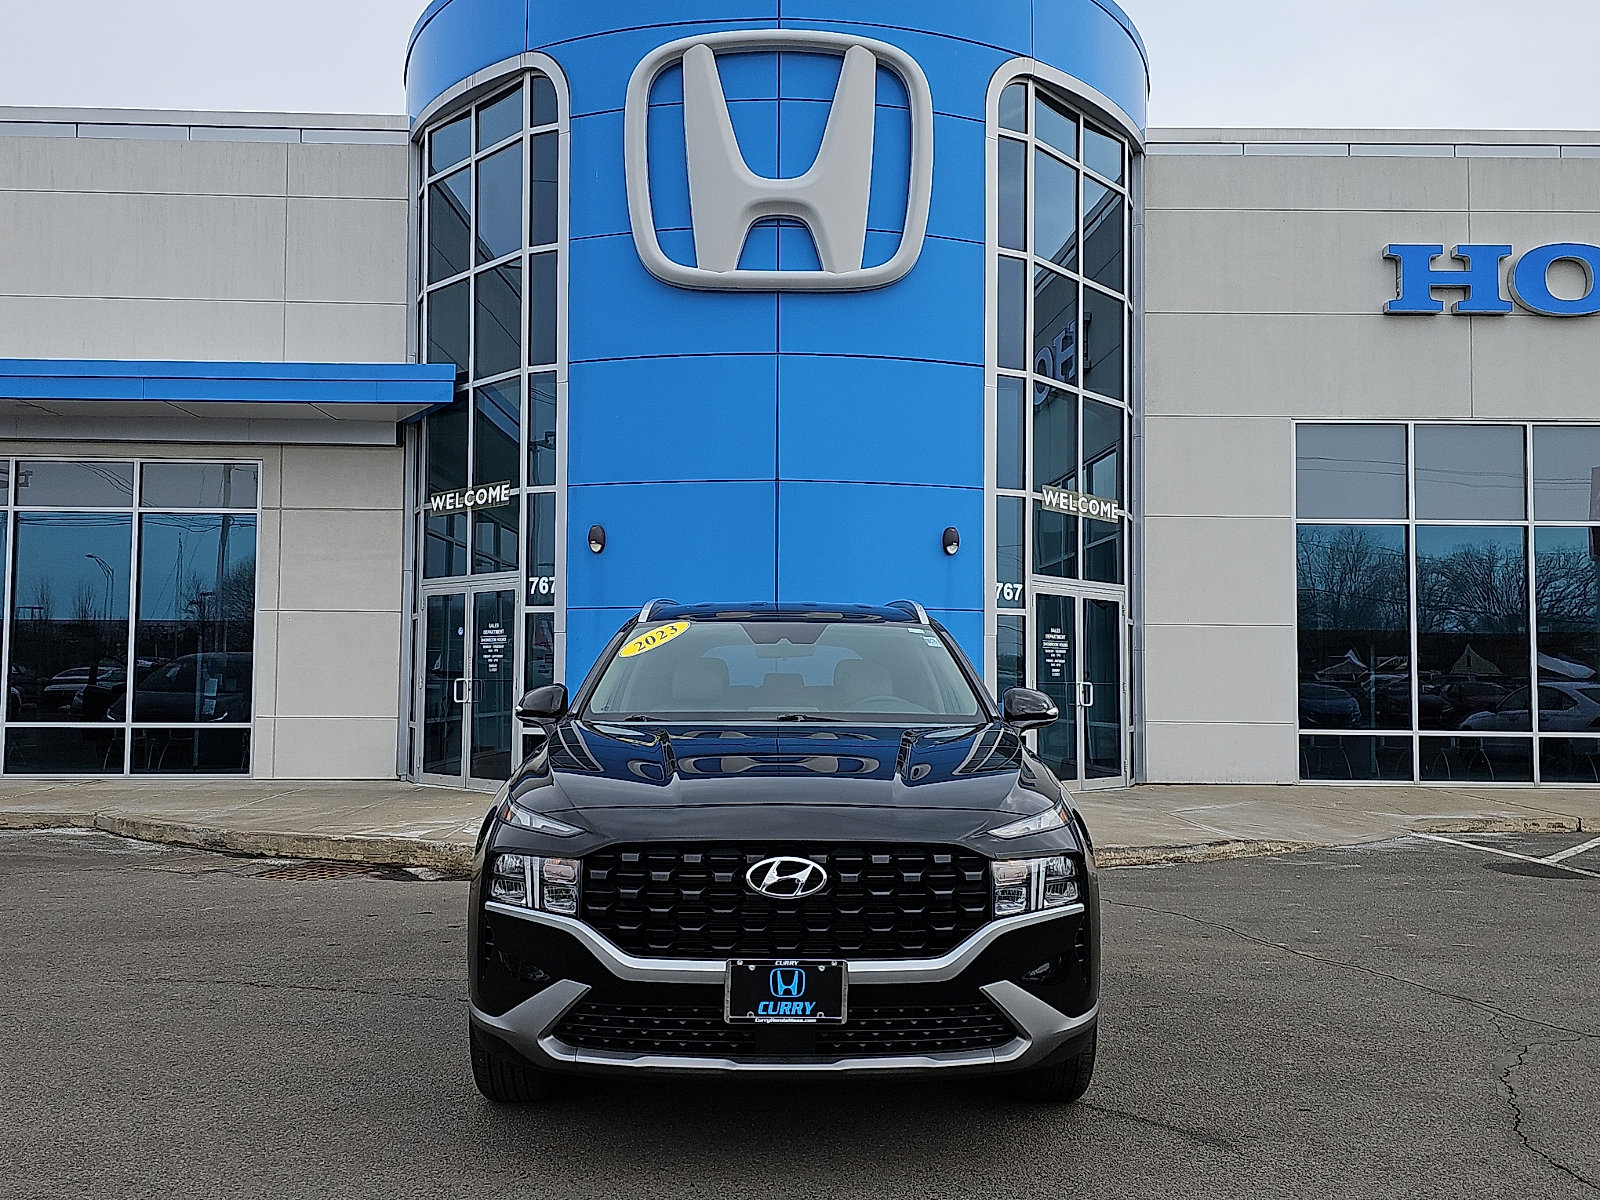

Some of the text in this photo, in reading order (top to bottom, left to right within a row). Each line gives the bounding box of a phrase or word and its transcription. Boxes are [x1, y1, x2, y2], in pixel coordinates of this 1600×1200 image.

[1382, 242, 1600, 317] HO
[430, 484, 510, 512] WELCOME
[1042, 488, 1119, 520] WELCOME
[529, 577, 556, 595] 767
[995, 582, 1024, 601] 767
[633, 625, 678, 652] 2023
[757, 1001, 817, 1015] CURRY
